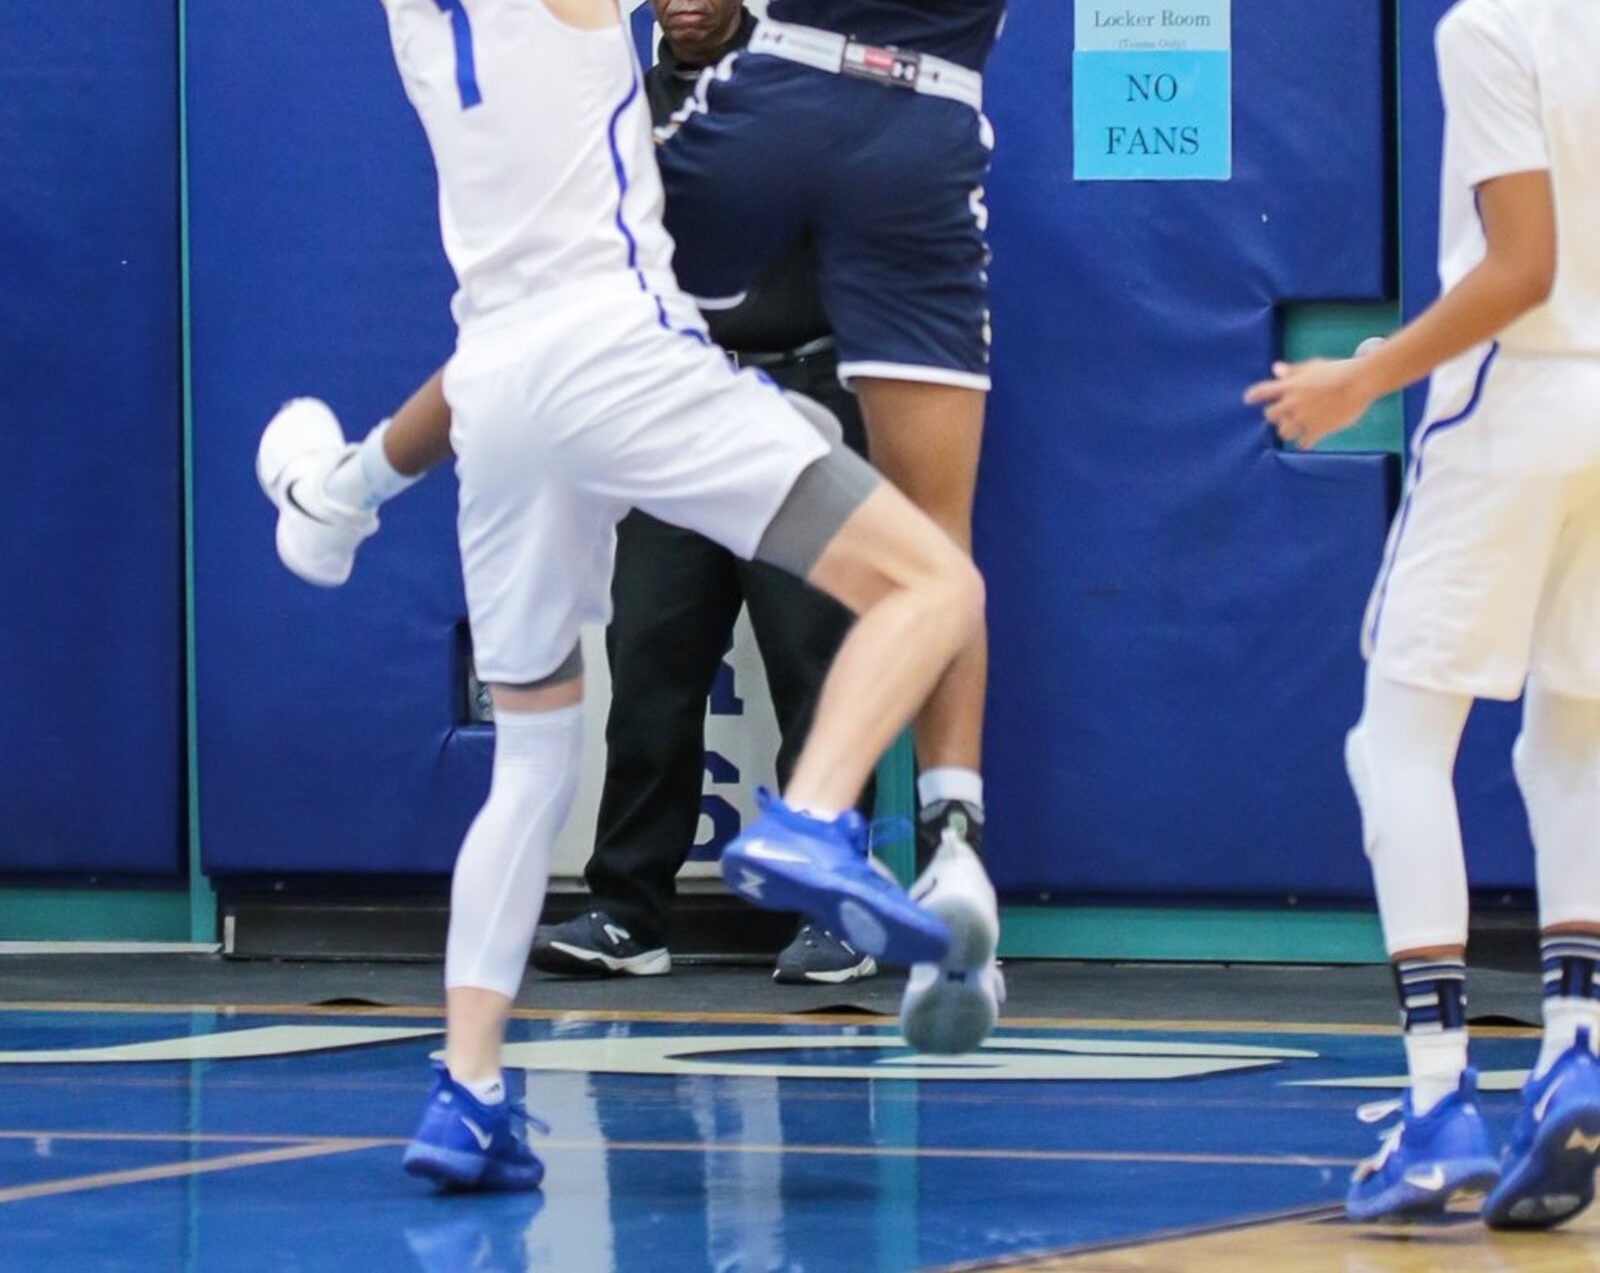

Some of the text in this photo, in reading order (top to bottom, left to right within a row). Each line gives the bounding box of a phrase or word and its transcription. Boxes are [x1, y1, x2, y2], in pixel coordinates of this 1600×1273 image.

[1094, 10, 1211, 28] Locker Room
[1126, 73, 1178, 103] NO
[1105, 127, 1200, 156] FANS
